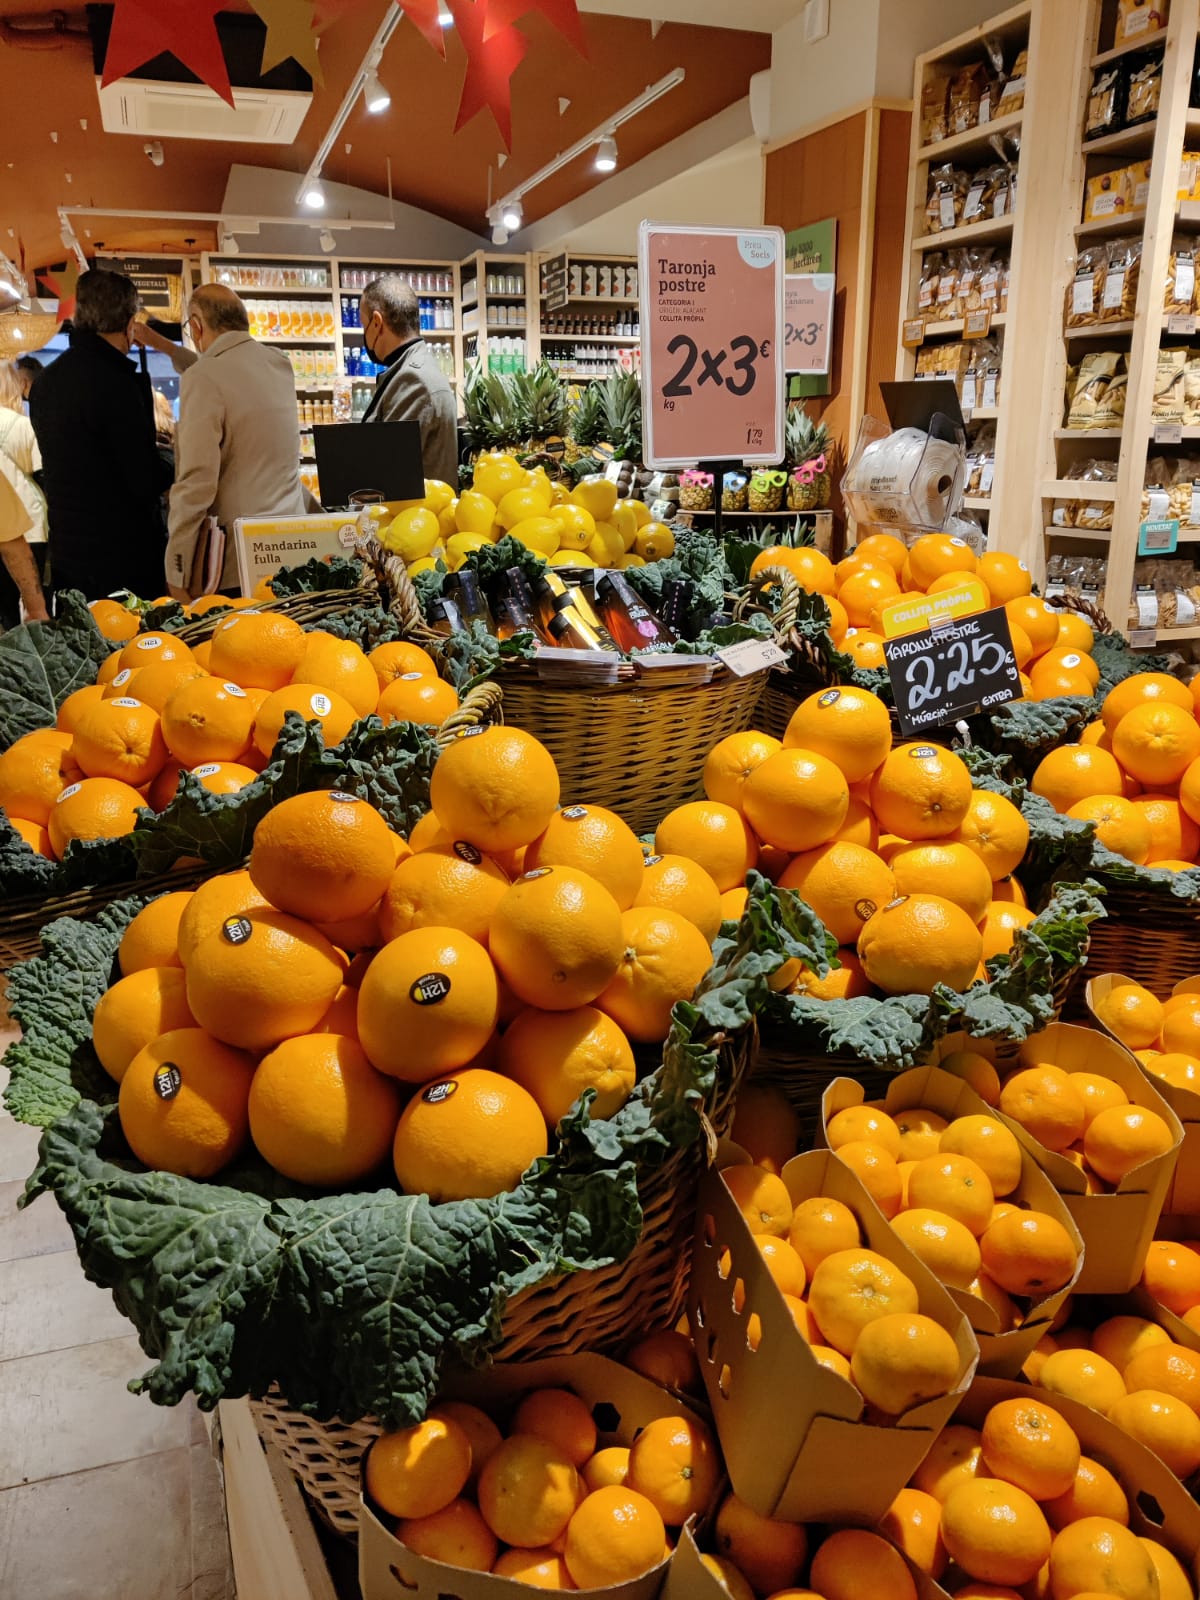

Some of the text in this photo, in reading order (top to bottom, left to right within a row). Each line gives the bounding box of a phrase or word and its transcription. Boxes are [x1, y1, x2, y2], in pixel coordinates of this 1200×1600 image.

[744, 240, 762, 249] Preu
[750, 250, 771, 258] Socis
[658, 259, 716, 279] Taronja
[658, 279, 706, 295] postre
[663, 399, 675, 411] kg
[252, 540, 317, 552] Mandarina
[254, 554, 281, 564] fulla
[893, 602, 932, 623] COLLITA
[982, 688, 1013, 706] EXTRA
[227, 923, 244, 942] 12H
[422, 981, 447, 1000] 12H
[158, 1072, 173, 1097] 12H
